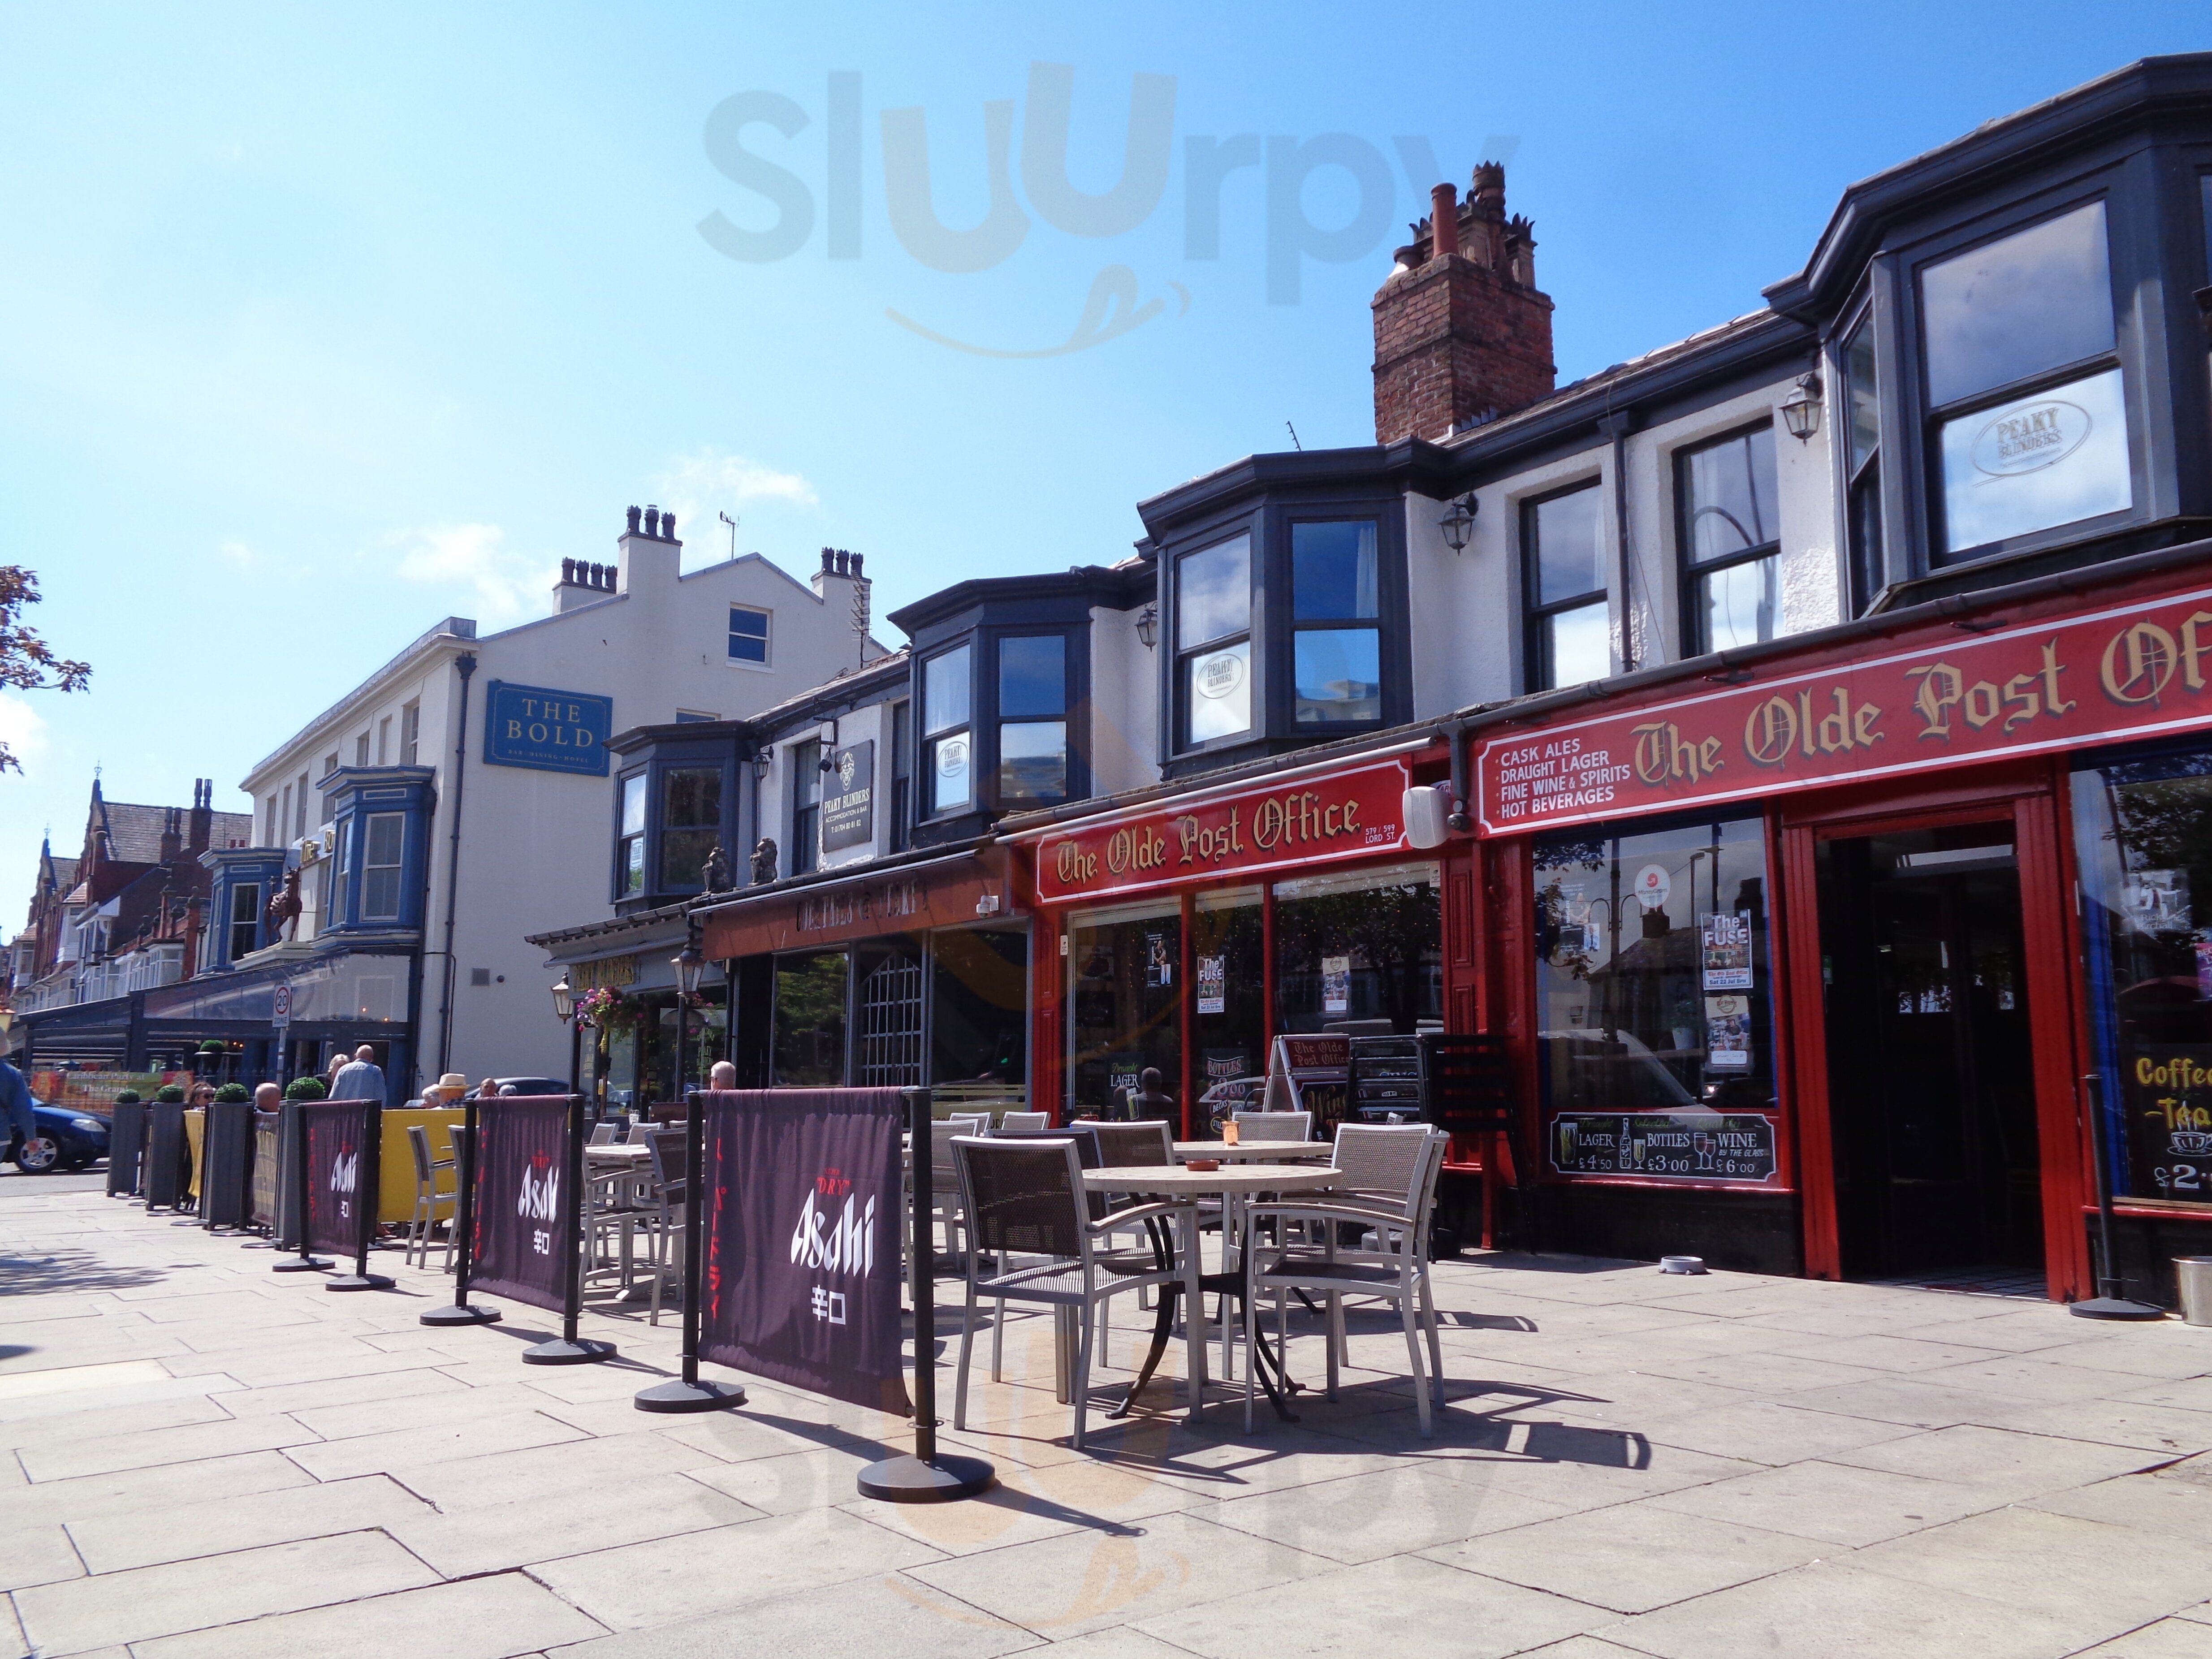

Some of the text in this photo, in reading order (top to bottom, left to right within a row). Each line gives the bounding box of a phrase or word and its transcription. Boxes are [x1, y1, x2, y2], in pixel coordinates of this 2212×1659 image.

[1996, 406, 2060, 443] PEAKY
[522, 698, 580, 723] THE
[1629, 719, 1724, 787] The
[1744, 686, 1884, 771] Olde
[1906, 636, 2076, 746] Post
[507, 719, 593, 748] BOLD
[1501, 739, 1581, 766] CASK ALES
[1501, 750, 1609, 784] DRAUGHT LAGER
[1501, 765, 1631, 801] FINE WINE & SPIRITS
[825, 788, 869, 814] PEAKY BLINDERS
[1501, 786, 1614, 819] HOT BEVERAGES
[1056, 791, 1361, 885] The Olde Post Office
[1365, 827, 1377, 835] 579
[1383, 824, 1395, 833] 599
[1365, 832, 1395, 843] LORD ST.
[1712, 915, 1740, 929] The
[1704, 928, 1748, 946] FUSE
[1203, 958, 1219, 968] The
[1199, 969, 1223, 981] FUSE
[278, 995, 287, 1006] 20
[1293, 1041, 1344, 1054] The Olde
[1207, 1058, 1241, 1074] BOTTLES
[1294, 1054, 1318, 1066] Post
[112, 1072, 133, 1081] Party
[1110, 1074, 1140, 1088] LAGER
[1213, 1099, 1228, 1113] BECKS
[1579, 1133, 1757, 1147] LAGER BOTTLES WINE
[1744, 1149, 1764, 1157] GLASS
[518, 1163, 559, 1223] Asahi
[534, 1228, 550, 1255] 辛口
[791, 1188, 875, 1279] Asahi
[811, 1284, 846, 1325] 辛口
